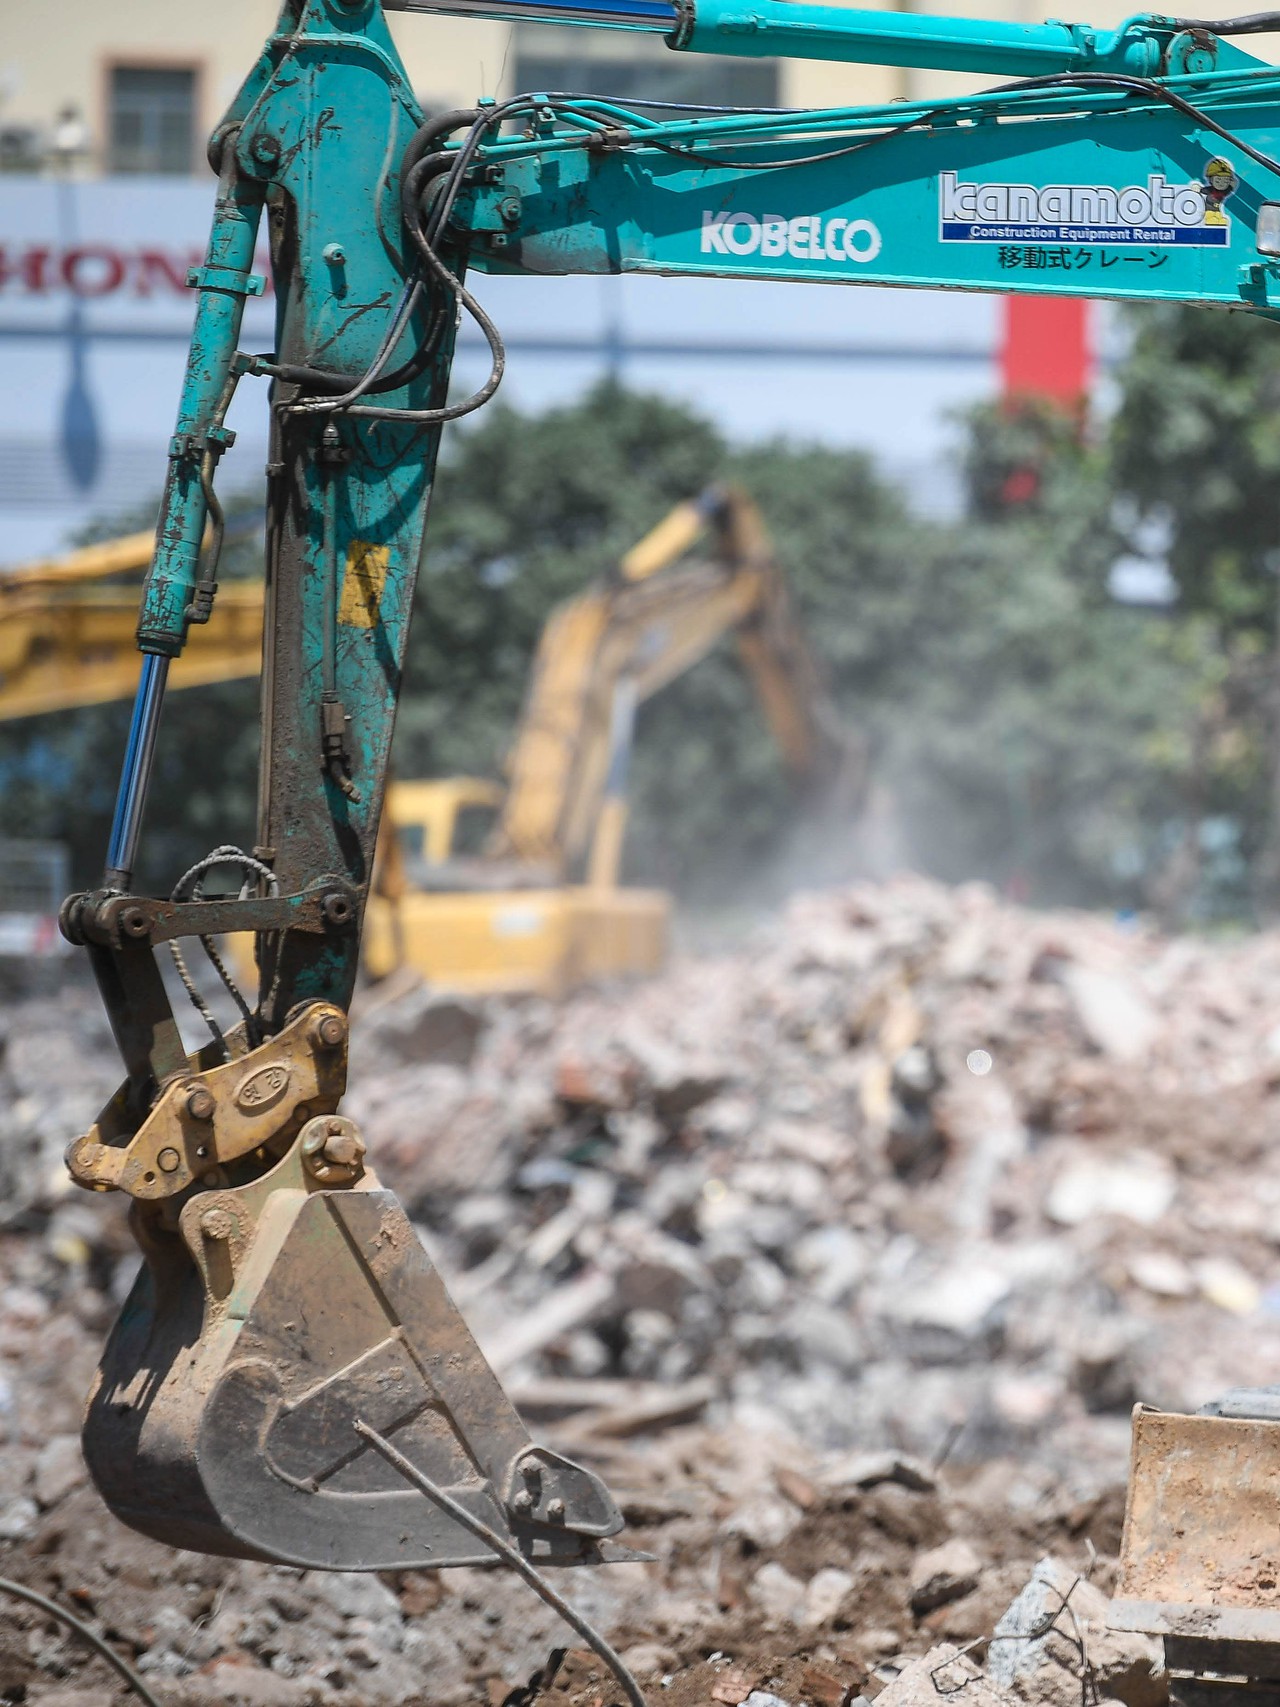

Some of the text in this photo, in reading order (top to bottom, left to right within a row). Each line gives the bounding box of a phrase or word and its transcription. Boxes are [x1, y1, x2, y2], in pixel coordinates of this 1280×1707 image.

[942, 172, 1206, 225] kanamoto
[700, 210, 882, 263] KOBELCO
[970, 225, 1176, 241] Construction Equipment Rental
[997, 246, 1169, 270] 移動式クレーン
